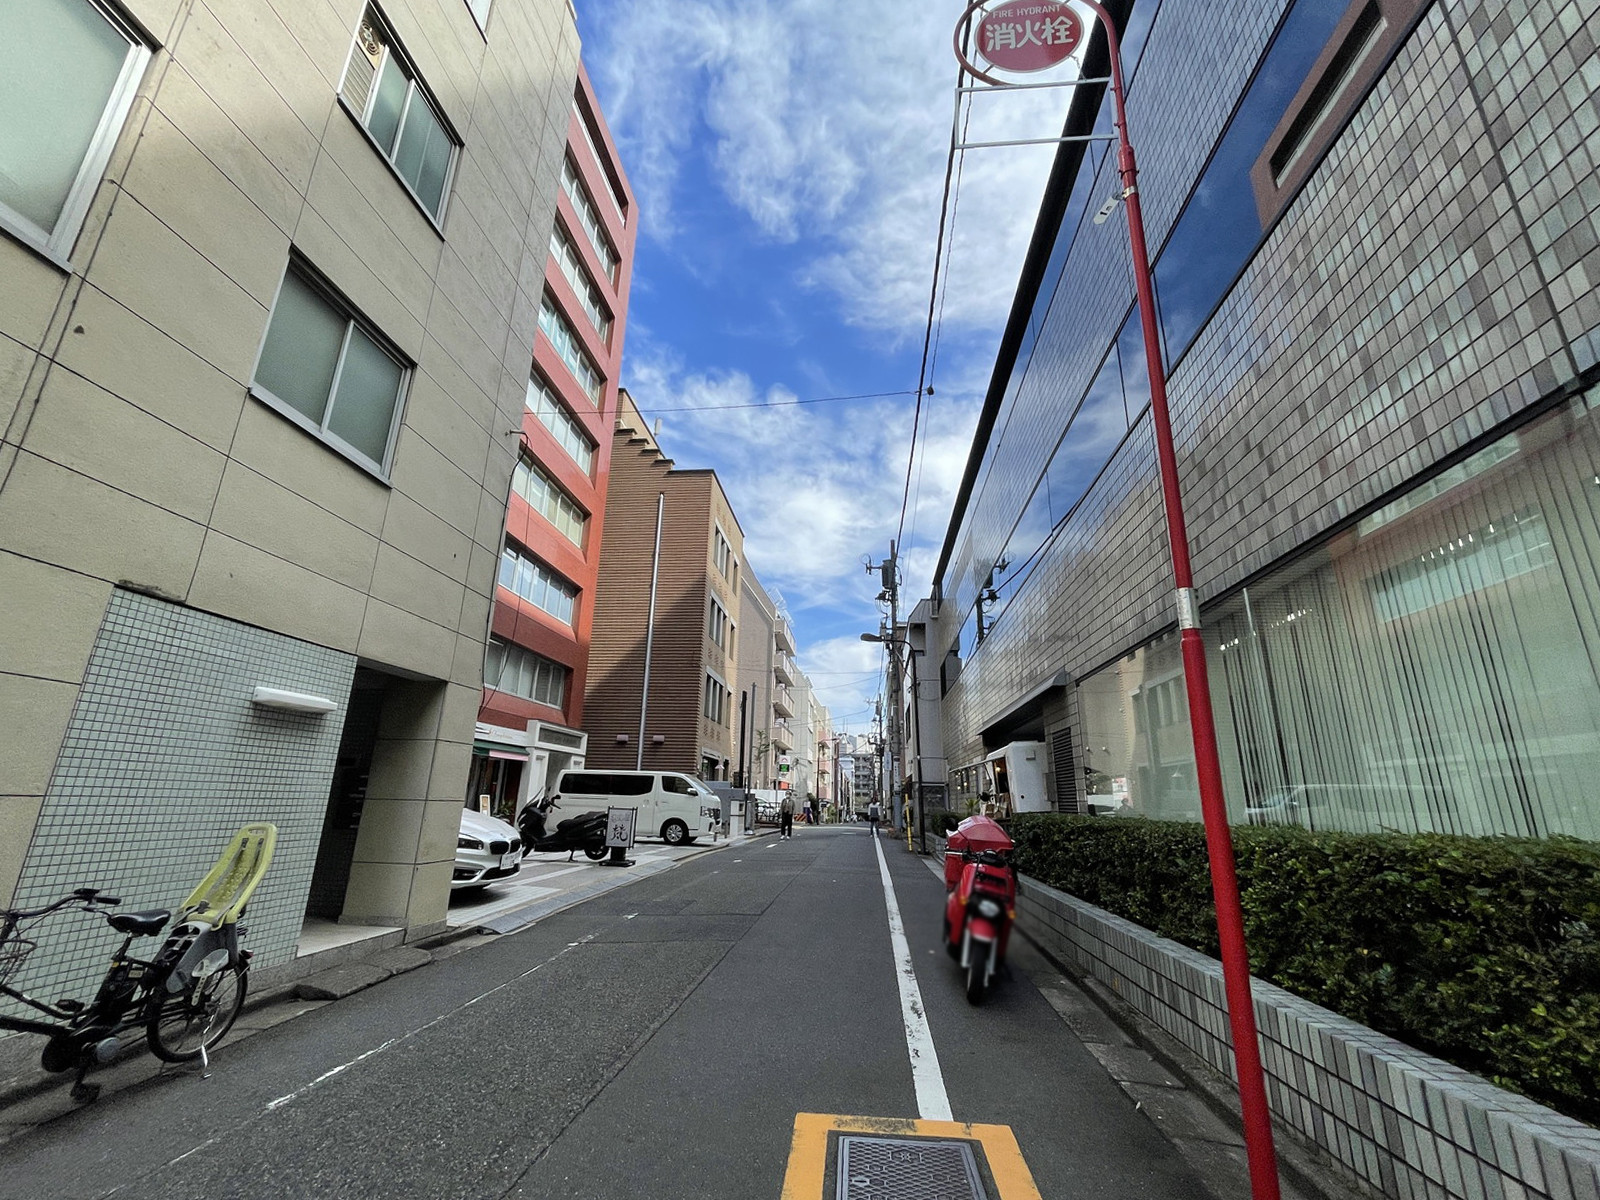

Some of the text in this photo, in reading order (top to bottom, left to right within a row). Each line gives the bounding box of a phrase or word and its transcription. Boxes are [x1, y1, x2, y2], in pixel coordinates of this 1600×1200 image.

[992, 4, 1061, 19] FIRE HYDRANT
[985, 16, 1074, 52] 消火栓
